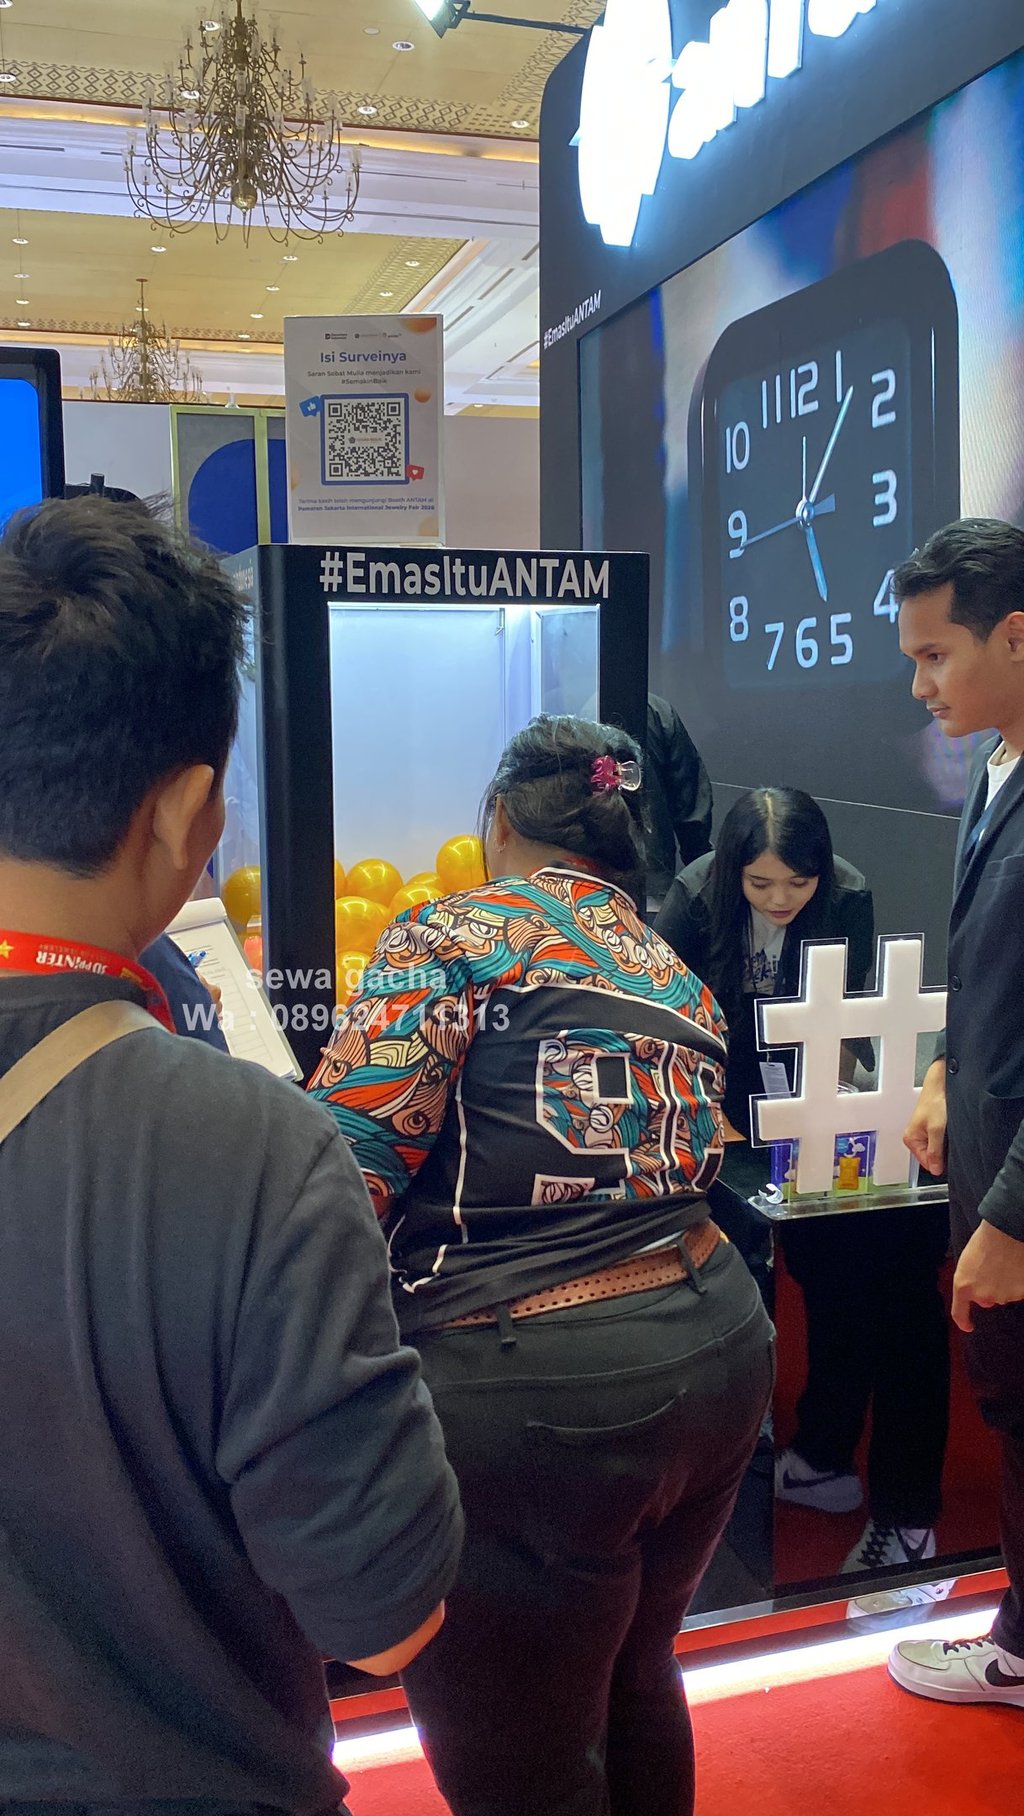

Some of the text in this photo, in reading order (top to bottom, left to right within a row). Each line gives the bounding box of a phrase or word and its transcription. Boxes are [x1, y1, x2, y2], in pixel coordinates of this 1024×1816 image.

[320, 350, 407, 364] Isi Surveinya
[762, 375, 782, 429] 11
[790, 361, 819, 420] 12
[871, 368, 896, 428] 2
[726, 421, 750, 474] 10
[872, 469, 897, 527] 3
[728, 510, 749, 558] 9
[319, 551, 609, 598] #EmasItuANTAM
[873, 569, 899, 624] 4
[730, 596, 749, 642] 8
[795, 617, 818, 668] 6
[830, 612, 853, 665] 5
[765, 622, 784, 671] 7
